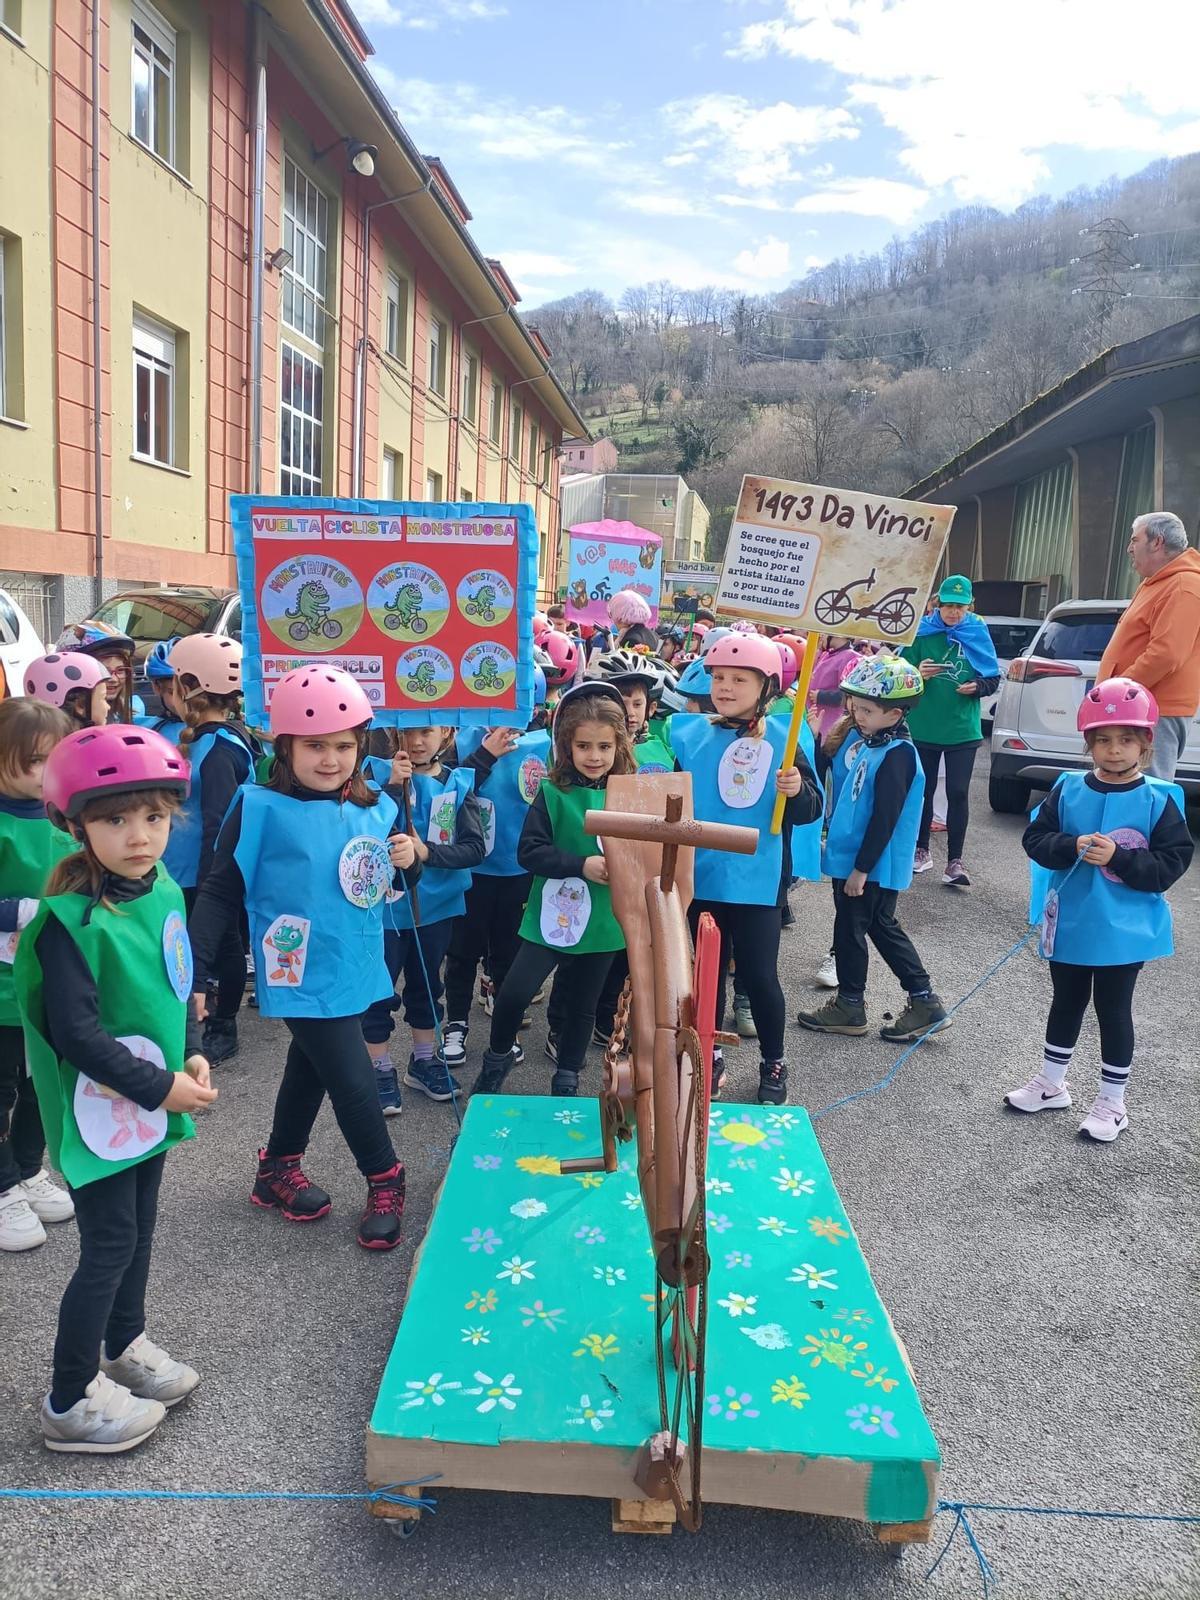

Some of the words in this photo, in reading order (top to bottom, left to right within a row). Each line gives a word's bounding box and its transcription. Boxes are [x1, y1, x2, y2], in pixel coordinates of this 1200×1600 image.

[755, 489, 814, 521] 1493
[820, 494, 854, 529] Da
[865, 504, 935, 542] Vinci
[253, 518, 321, 533] VUELTA
[325, 520, 401, 535] CICLISTA
[407, 522, 514, 537] MONSTRUOSA
[740, 531, 753, 540] Se
[755, 534, 777, 544] cree
[779, 539, 797, 548] que
[799, 541, 810, 550] el
[741, 543, 784, 559] bosquejo
[787, 551, 804, 562] fue
[678, 562, 699, 571] Hand
[700, 563, 716, 572] bike
[738, 556, 769, 568] hecho
[770, 563, 788, 571] por
[790, 565, 800, 573] el
[268, 560, 353, 593] MONSTRUITOS
[728, 567, 763, 579] artista
[765, 572, 805, 586] italiano
[741, 582, 759, 590] por
[760, 585, 780, 594] uno
[782, 588, 794, 597] de
[721, 591, 739, 600] sus
[741, 594, 800, 610] estudiantes
